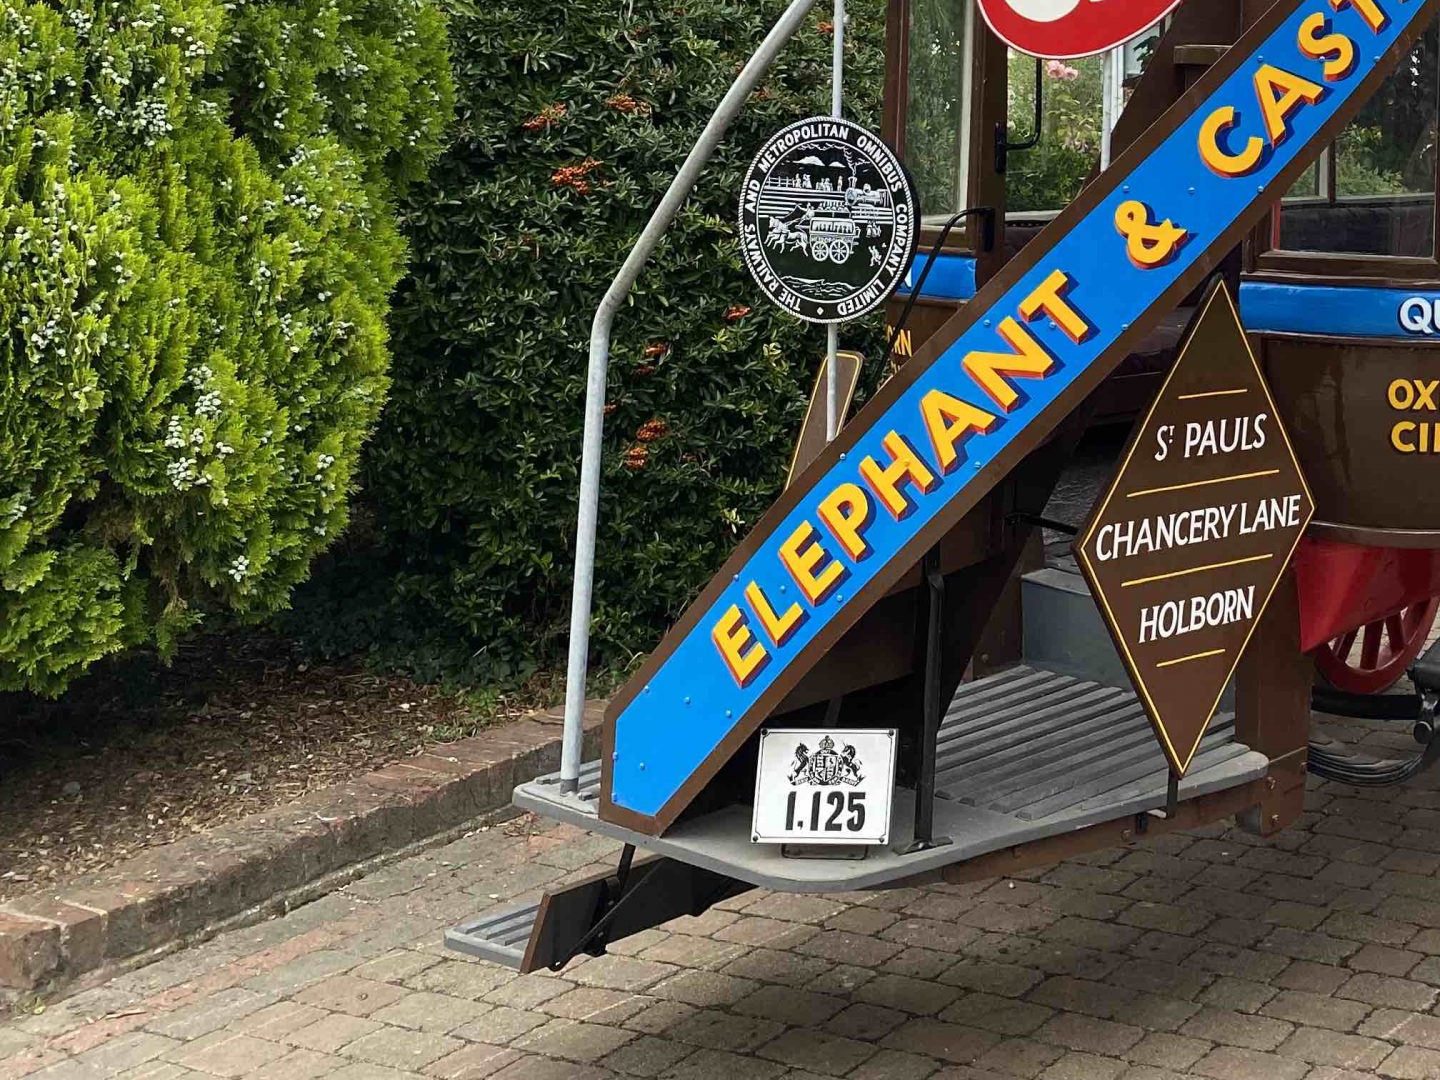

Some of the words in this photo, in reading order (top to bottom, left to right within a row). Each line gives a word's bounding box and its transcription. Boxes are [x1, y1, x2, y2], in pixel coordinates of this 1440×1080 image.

[757, 123, 850, 173] METROPOLITAN
[856, 135, 903, 193] OMNIBUS
[745, 180, 761, 214] AND
[744, 223, 780, 290] RAILWAYS
[886, 203, 908, 276] COMPANY
[778, 288, 801, 312] THE
[836, 279, 885, 316] LIMITED
[713, 271, 1089, 689] ELEPHANT
[1116, 202, 1187, 266] &
[1184, 413, 1267, 458] PAULS
[1096, 503, 1238, 561] CHANCERY
[1239, 494, 1301, 535] LANE
[1138, 585, 1256, 643] HOLBORN
